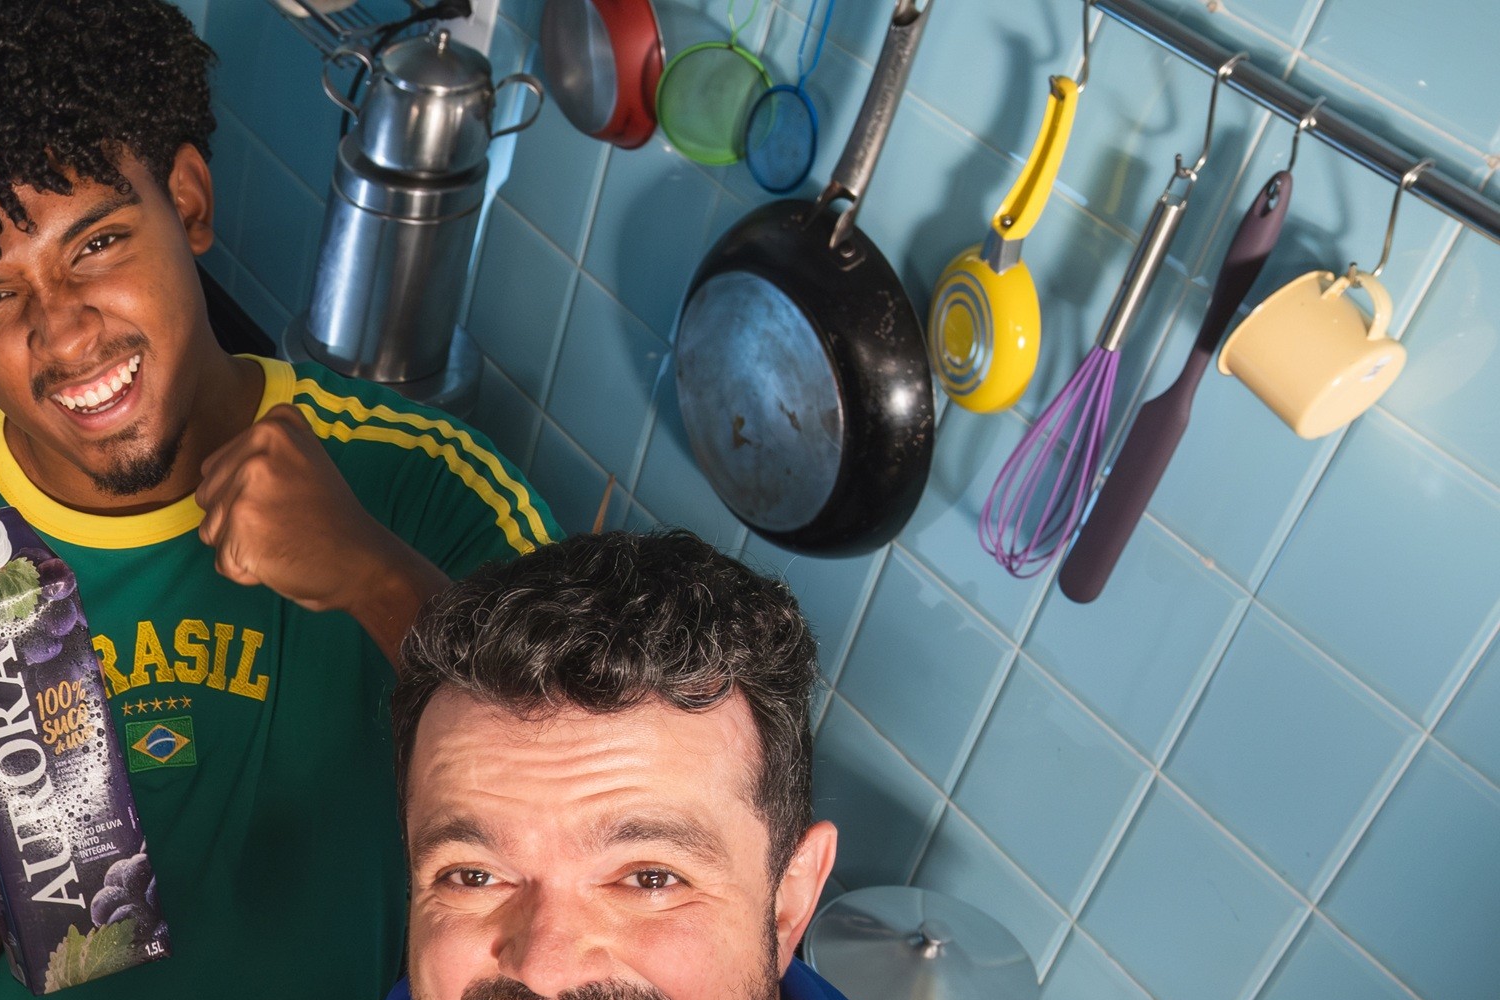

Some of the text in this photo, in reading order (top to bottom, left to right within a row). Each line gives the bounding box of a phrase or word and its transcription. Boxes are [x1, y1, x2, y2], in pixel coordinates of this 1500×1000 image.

[91, 619, 270, 701] RASIL
[35, 678, 87, 721] 100%
[95, 824, 107, 834] DE
[105, 818, 123, 830] UVA
[79, 841, 117, 859] INTEGRAL
